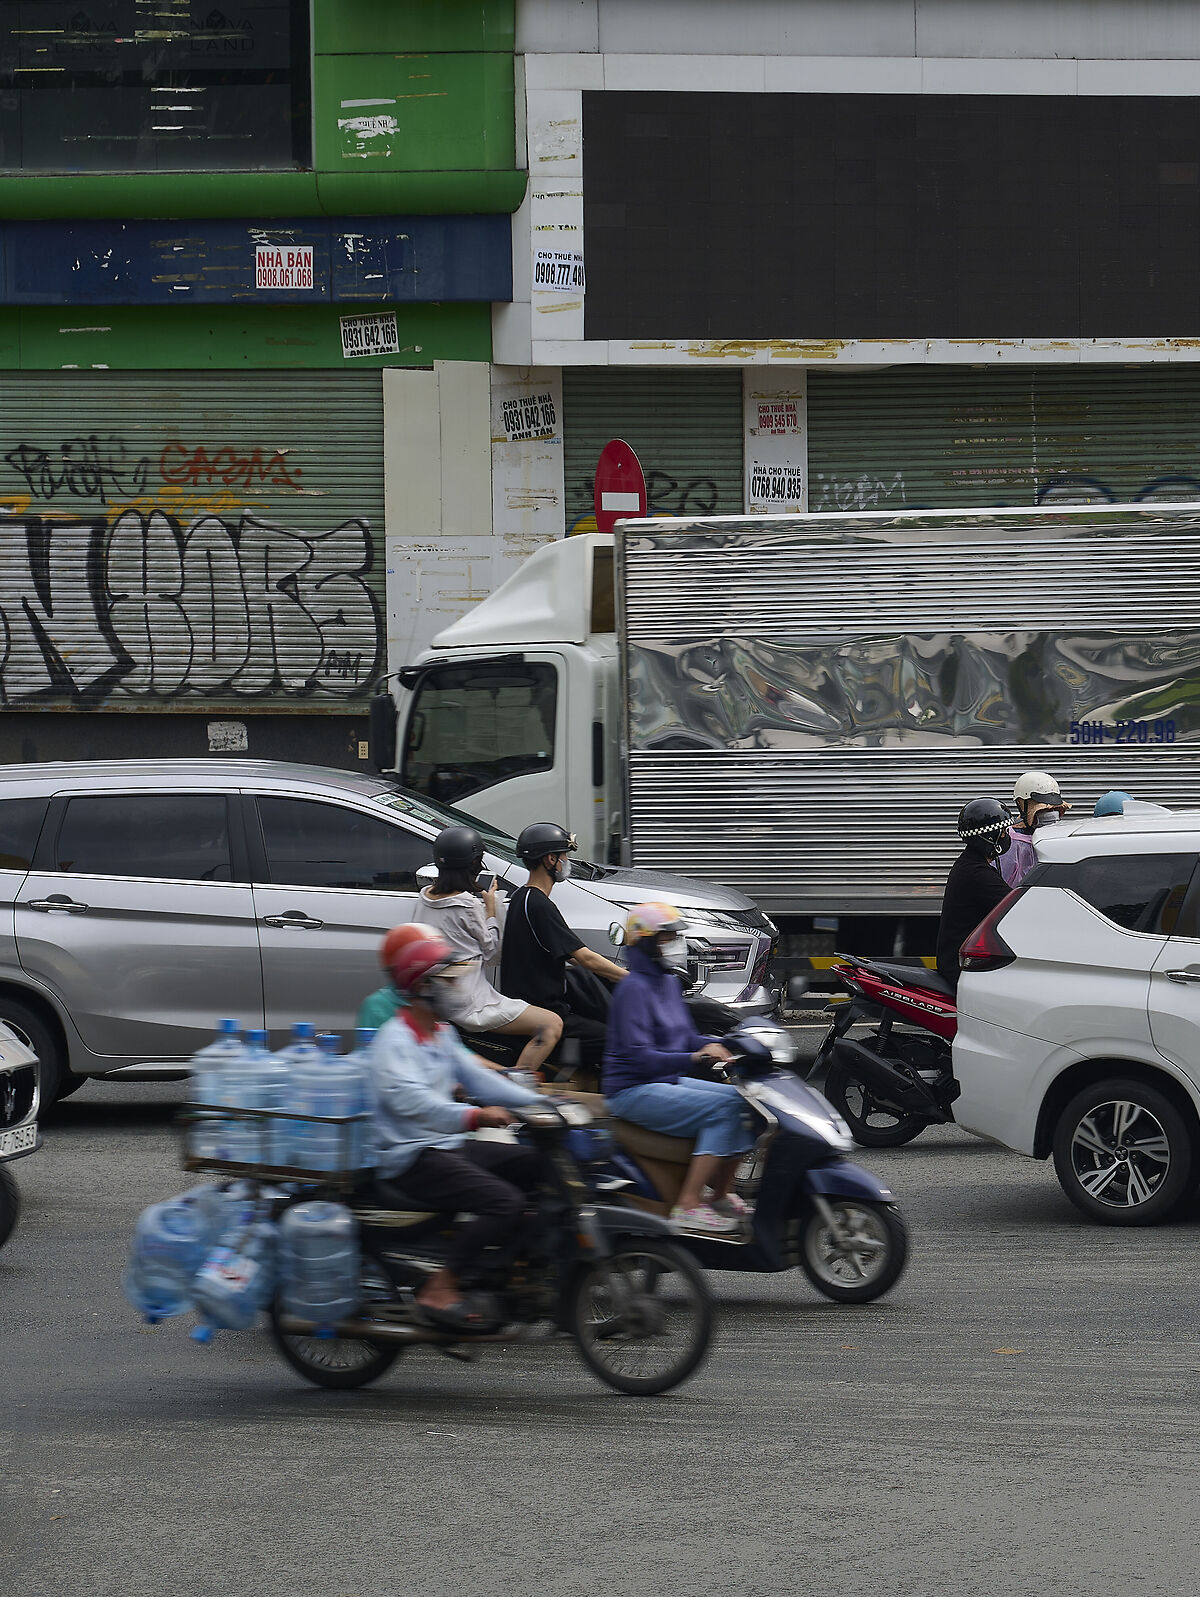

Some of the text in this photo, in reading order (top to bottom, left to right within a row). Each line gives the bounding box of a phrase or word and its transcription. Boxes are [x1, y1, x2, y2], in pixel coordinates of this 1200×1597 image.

[258, 248, 312, 269] NHÀ BÁN
[537, 252, 553, 260] CHO
[554, 252, 572, 262] THUÊ
[257, 268, 312, 288] 0908.061.068
[342, 318, 358, 328] CHO
[343, 323, 397, 350] 0931 642 166
[350, 348, 371, 358] ANH
[502, 391, 553, 411] CHO THUÊ NHÀ
[759, 405, 770, 414] CHO
[770, 403, 785, 413] THUÊ
[503, 403, 556, 434] 0931 642 166
[512, 430, 533, 442] ANH
[753, 464, 801, 478] NHÀ CHO THUÊ
[751, 476, 802, 501] 0768.940.935
